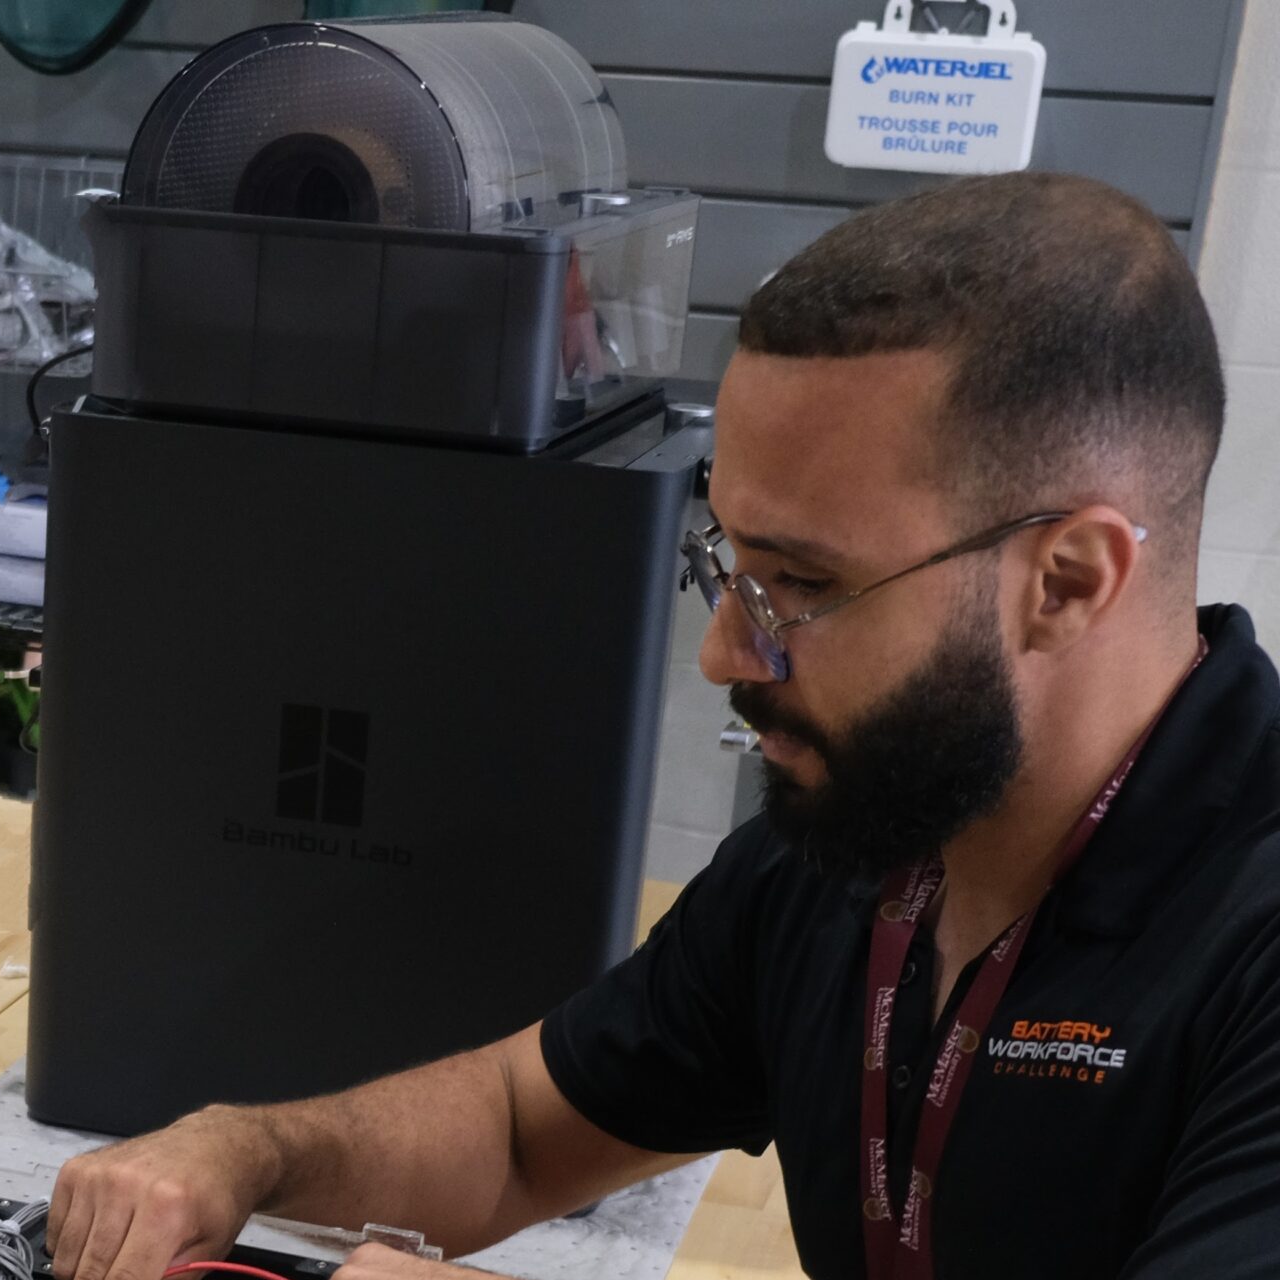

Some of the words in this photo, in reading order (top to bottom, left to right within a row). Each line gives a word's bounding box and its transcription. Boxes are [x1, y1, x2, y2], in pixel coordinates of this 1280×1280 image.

[888, 88, 940, 104] BURN
[945, 93, 976, 107] KIT
[857, 115, 941, 134] TROUSSE
[947, 121, 999, 138] POUR
[882, 134, 968, 155] BRÛLURE
[223, 822, 340, 857] Bambu
[350, 839, 413, 867] Lab
[875, 987, 896, 1070] McMaster
[1011, 1020, 1112, 1044] BATTERY
[926, 1020, 962, 1101] McMaster
[988, 1038, 1126, 1068] WORKFORCE
[993, 1062, 1106, 1084] CHALLENGE
